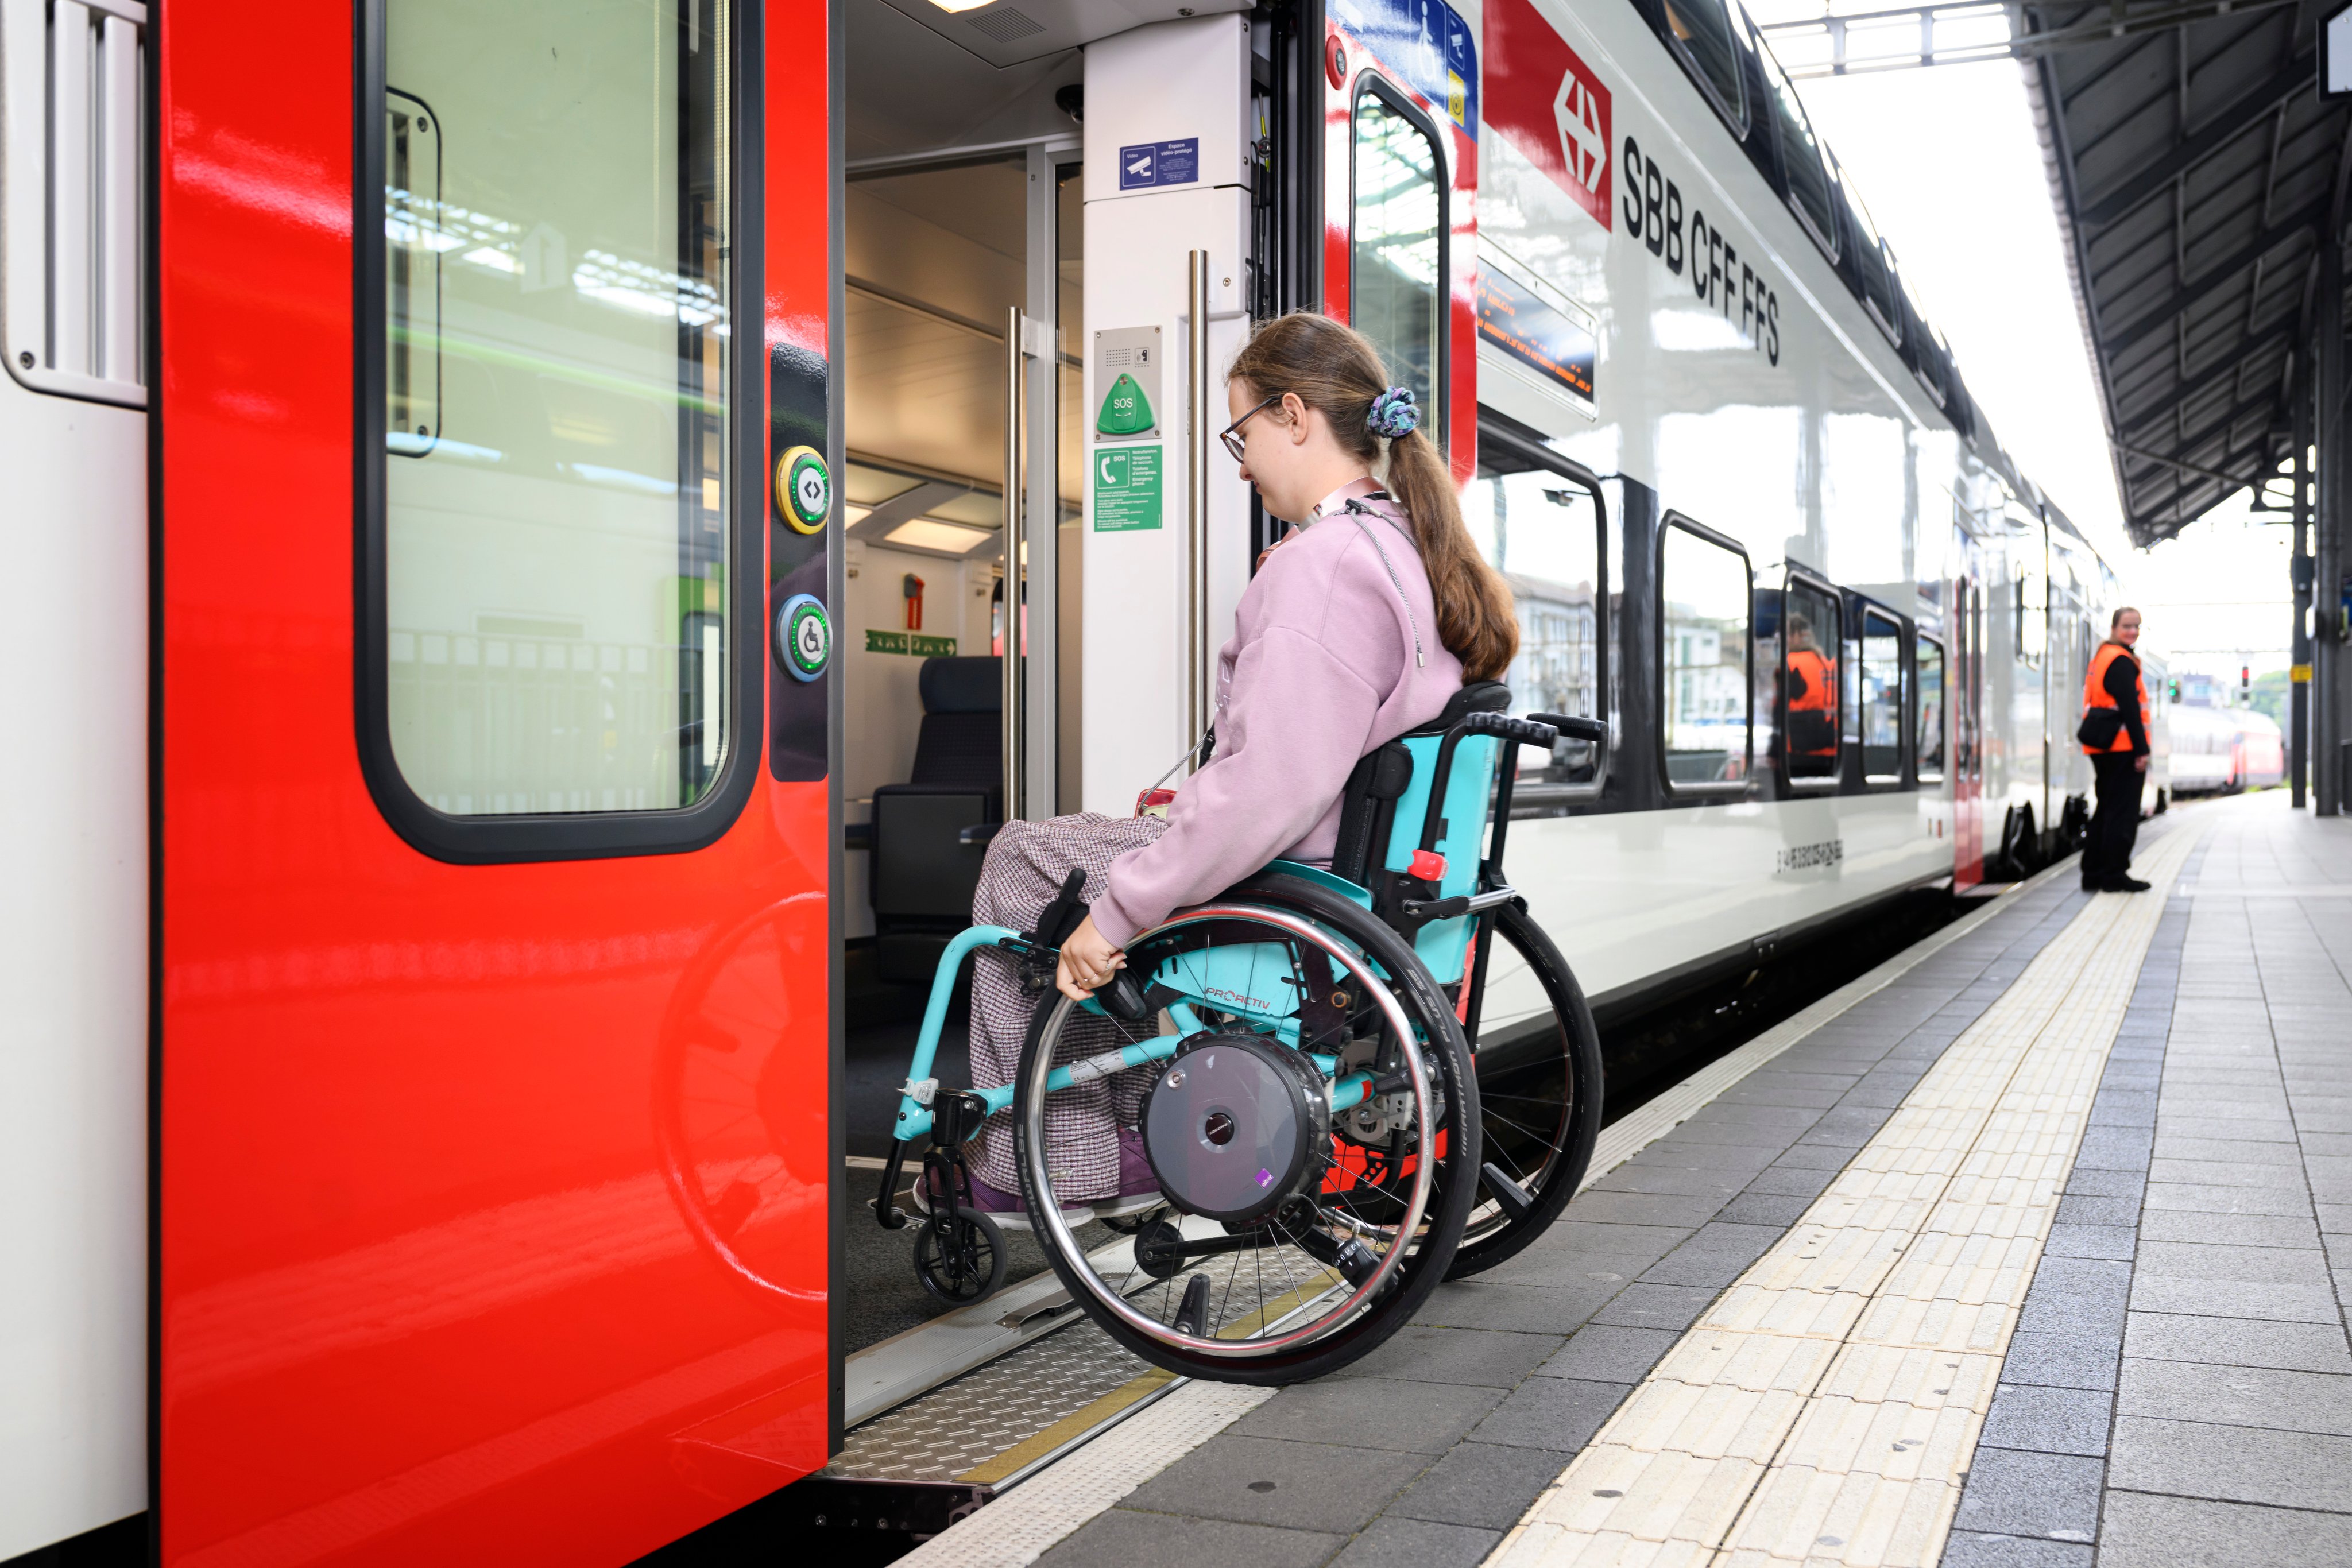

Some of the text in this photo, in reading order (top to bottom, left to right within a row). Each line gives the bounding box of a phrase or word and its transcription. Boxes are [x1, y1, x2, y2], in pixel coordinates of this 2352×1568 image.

[1623, 135, 1779, 367] SBB CFF FFS
[1114, 397, 1133, 409] SOS
[1205, 986, 1271, 1009] PROACTIV
[1425, 996, 1467, 1157] MARATHON PLUS
[1018, 1123, 1052, 1244] SCHWALBE
